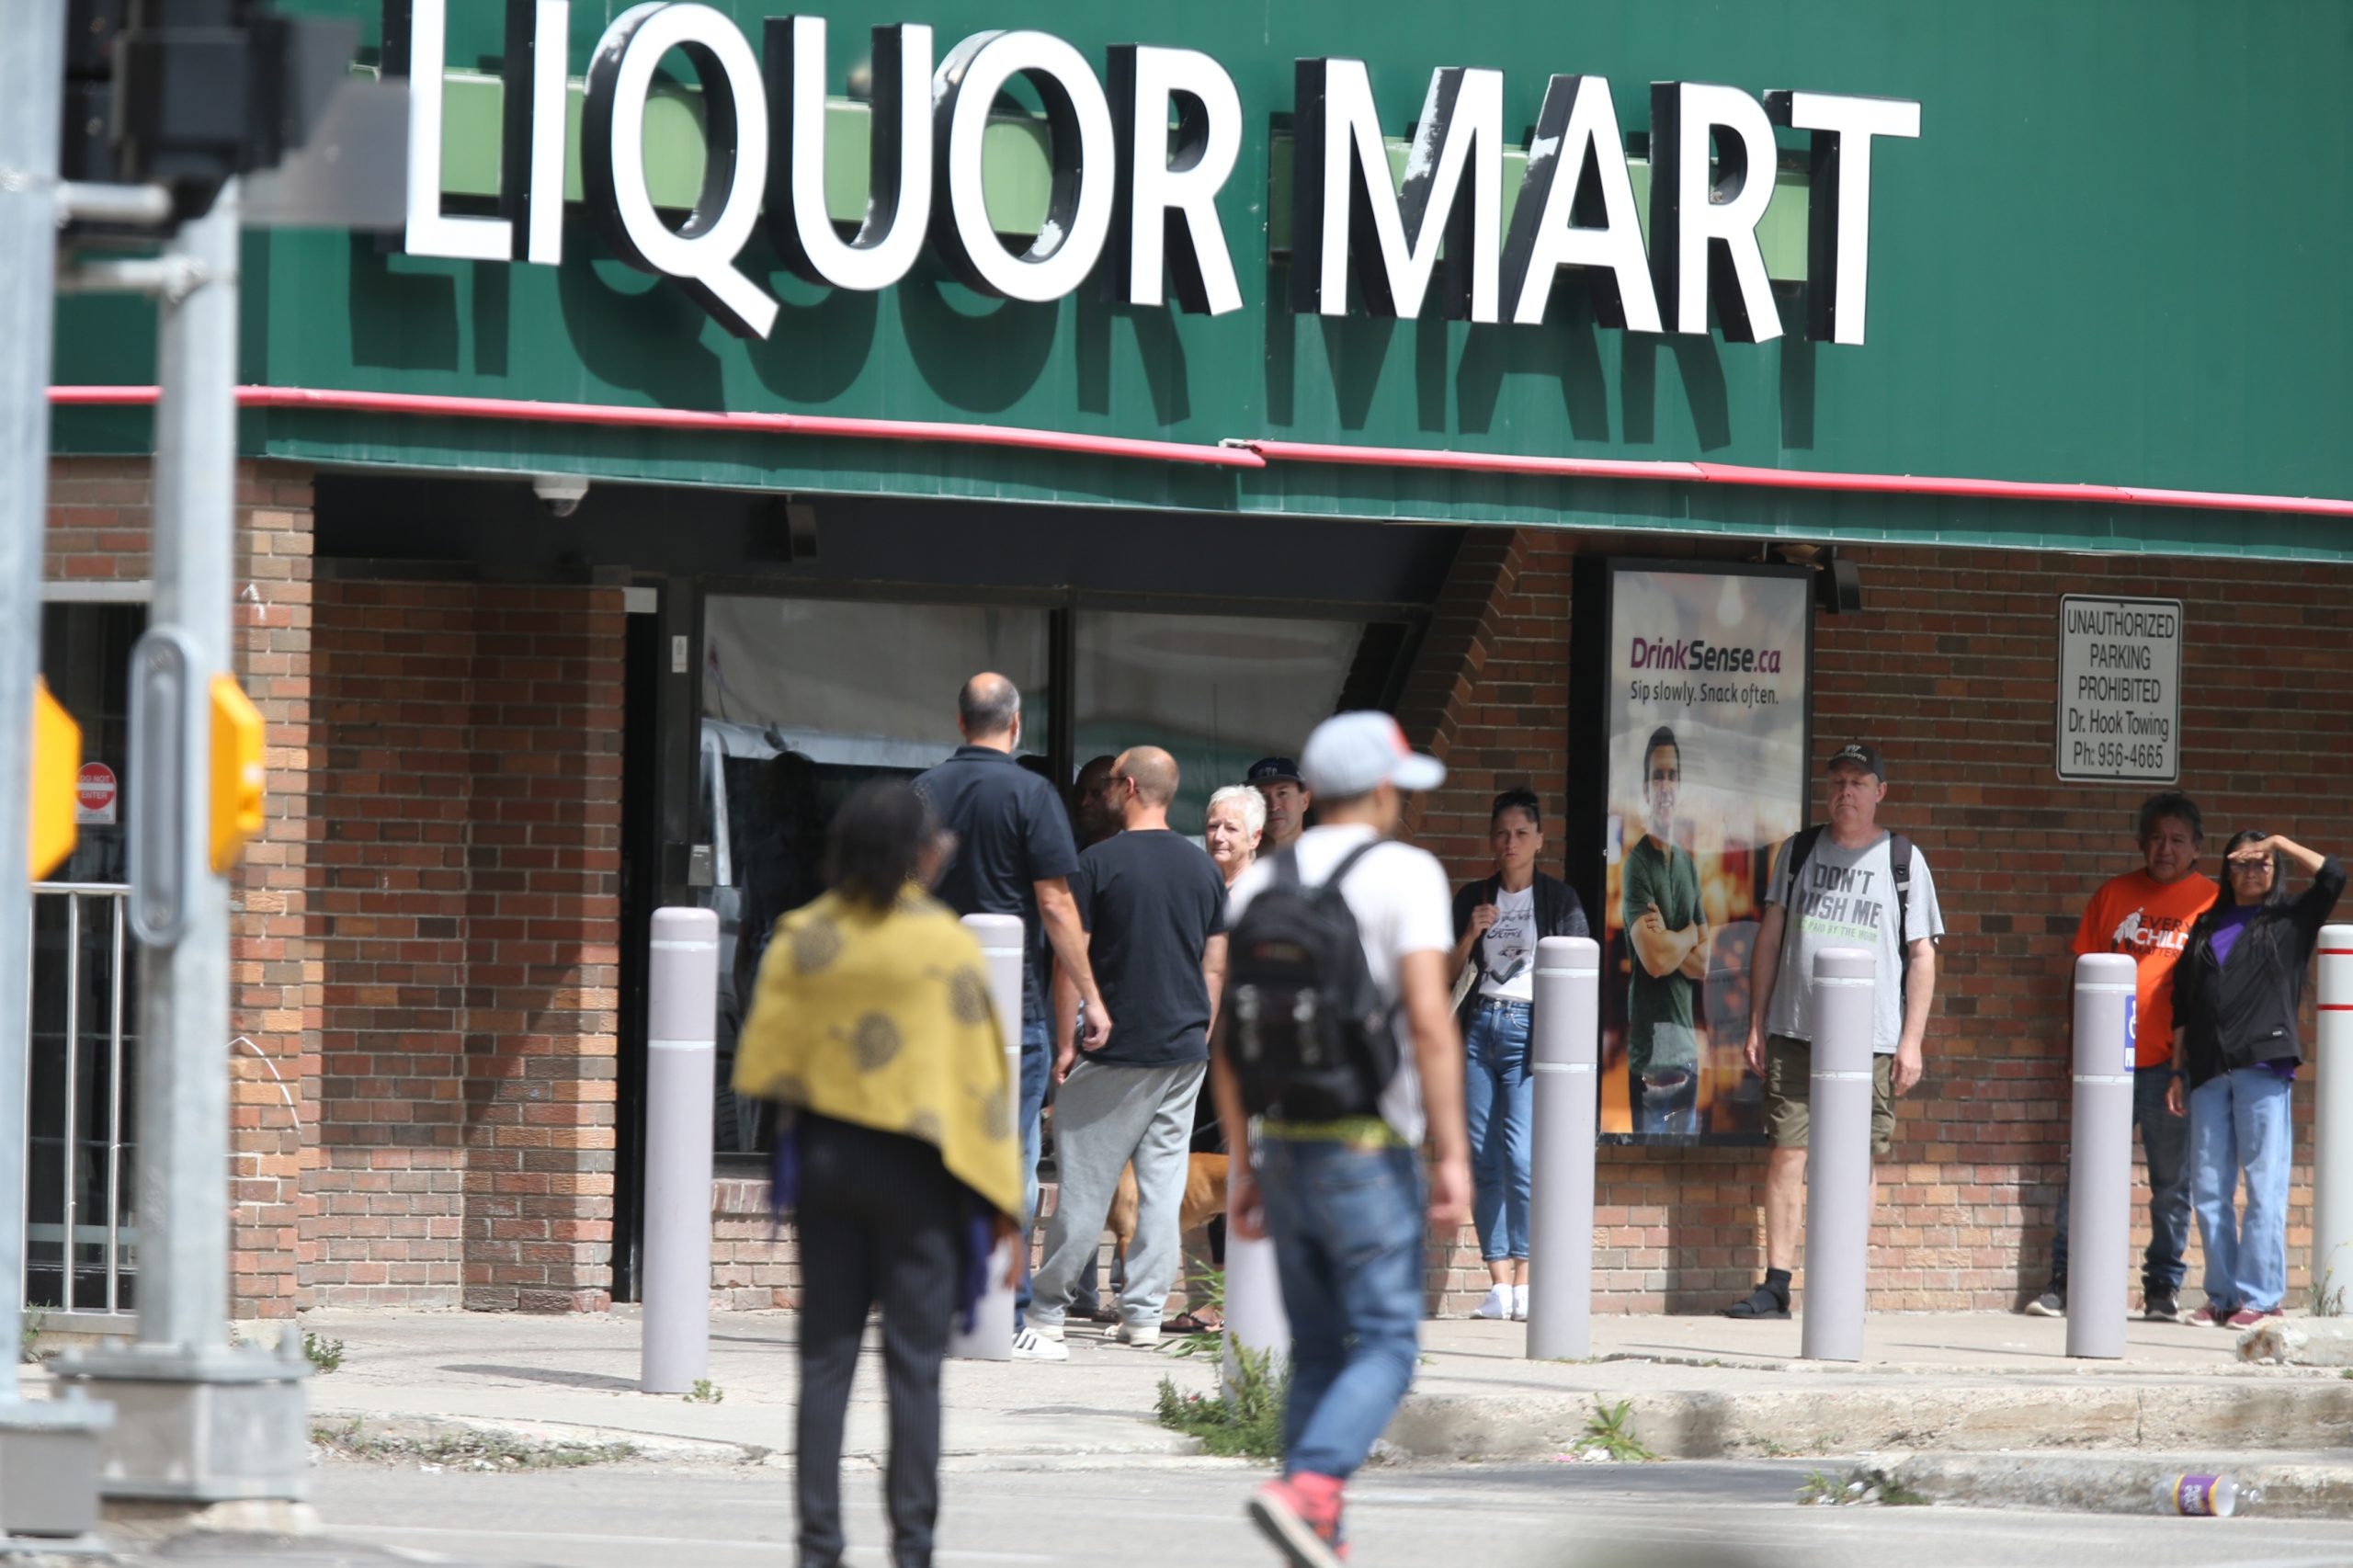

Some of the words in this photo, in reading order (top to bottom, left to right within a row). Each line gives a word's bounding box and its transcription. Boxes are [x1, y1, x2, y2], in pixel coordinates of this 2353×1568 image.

[405, 0, 1243, 340] LIQUOR
[1321, 58, 1922, 346] MART
[2067, 608, 2175, 639] UNAUTHORIZED
[1630, 637, 1781, 674] DrinkSense.ca
[2090, 643, 2151, 670] PARKING
[1631, 680, 1650, 705] Sip
[1654, 680, 1697, 707] slowly.
[1700, 683, 1738, 704] Snack
[1741, 684, 1779, 708] often.
[2078, 676, 2161, 703] PROHIBITED
[2069, 708, 2086, 733] Dr.
[2089, 709, 2123, 734] Hook
[2125, 710, 2169, 743] Towing
[2074, 741, 2095, 766] Ph:
[2097, 742, 2163, 768] 956-4665
[1813, 863, 1875, 894] DON'T
[1851, 899, 1882, 928] ME
[2133, 944, 2181, 959] MATTER
